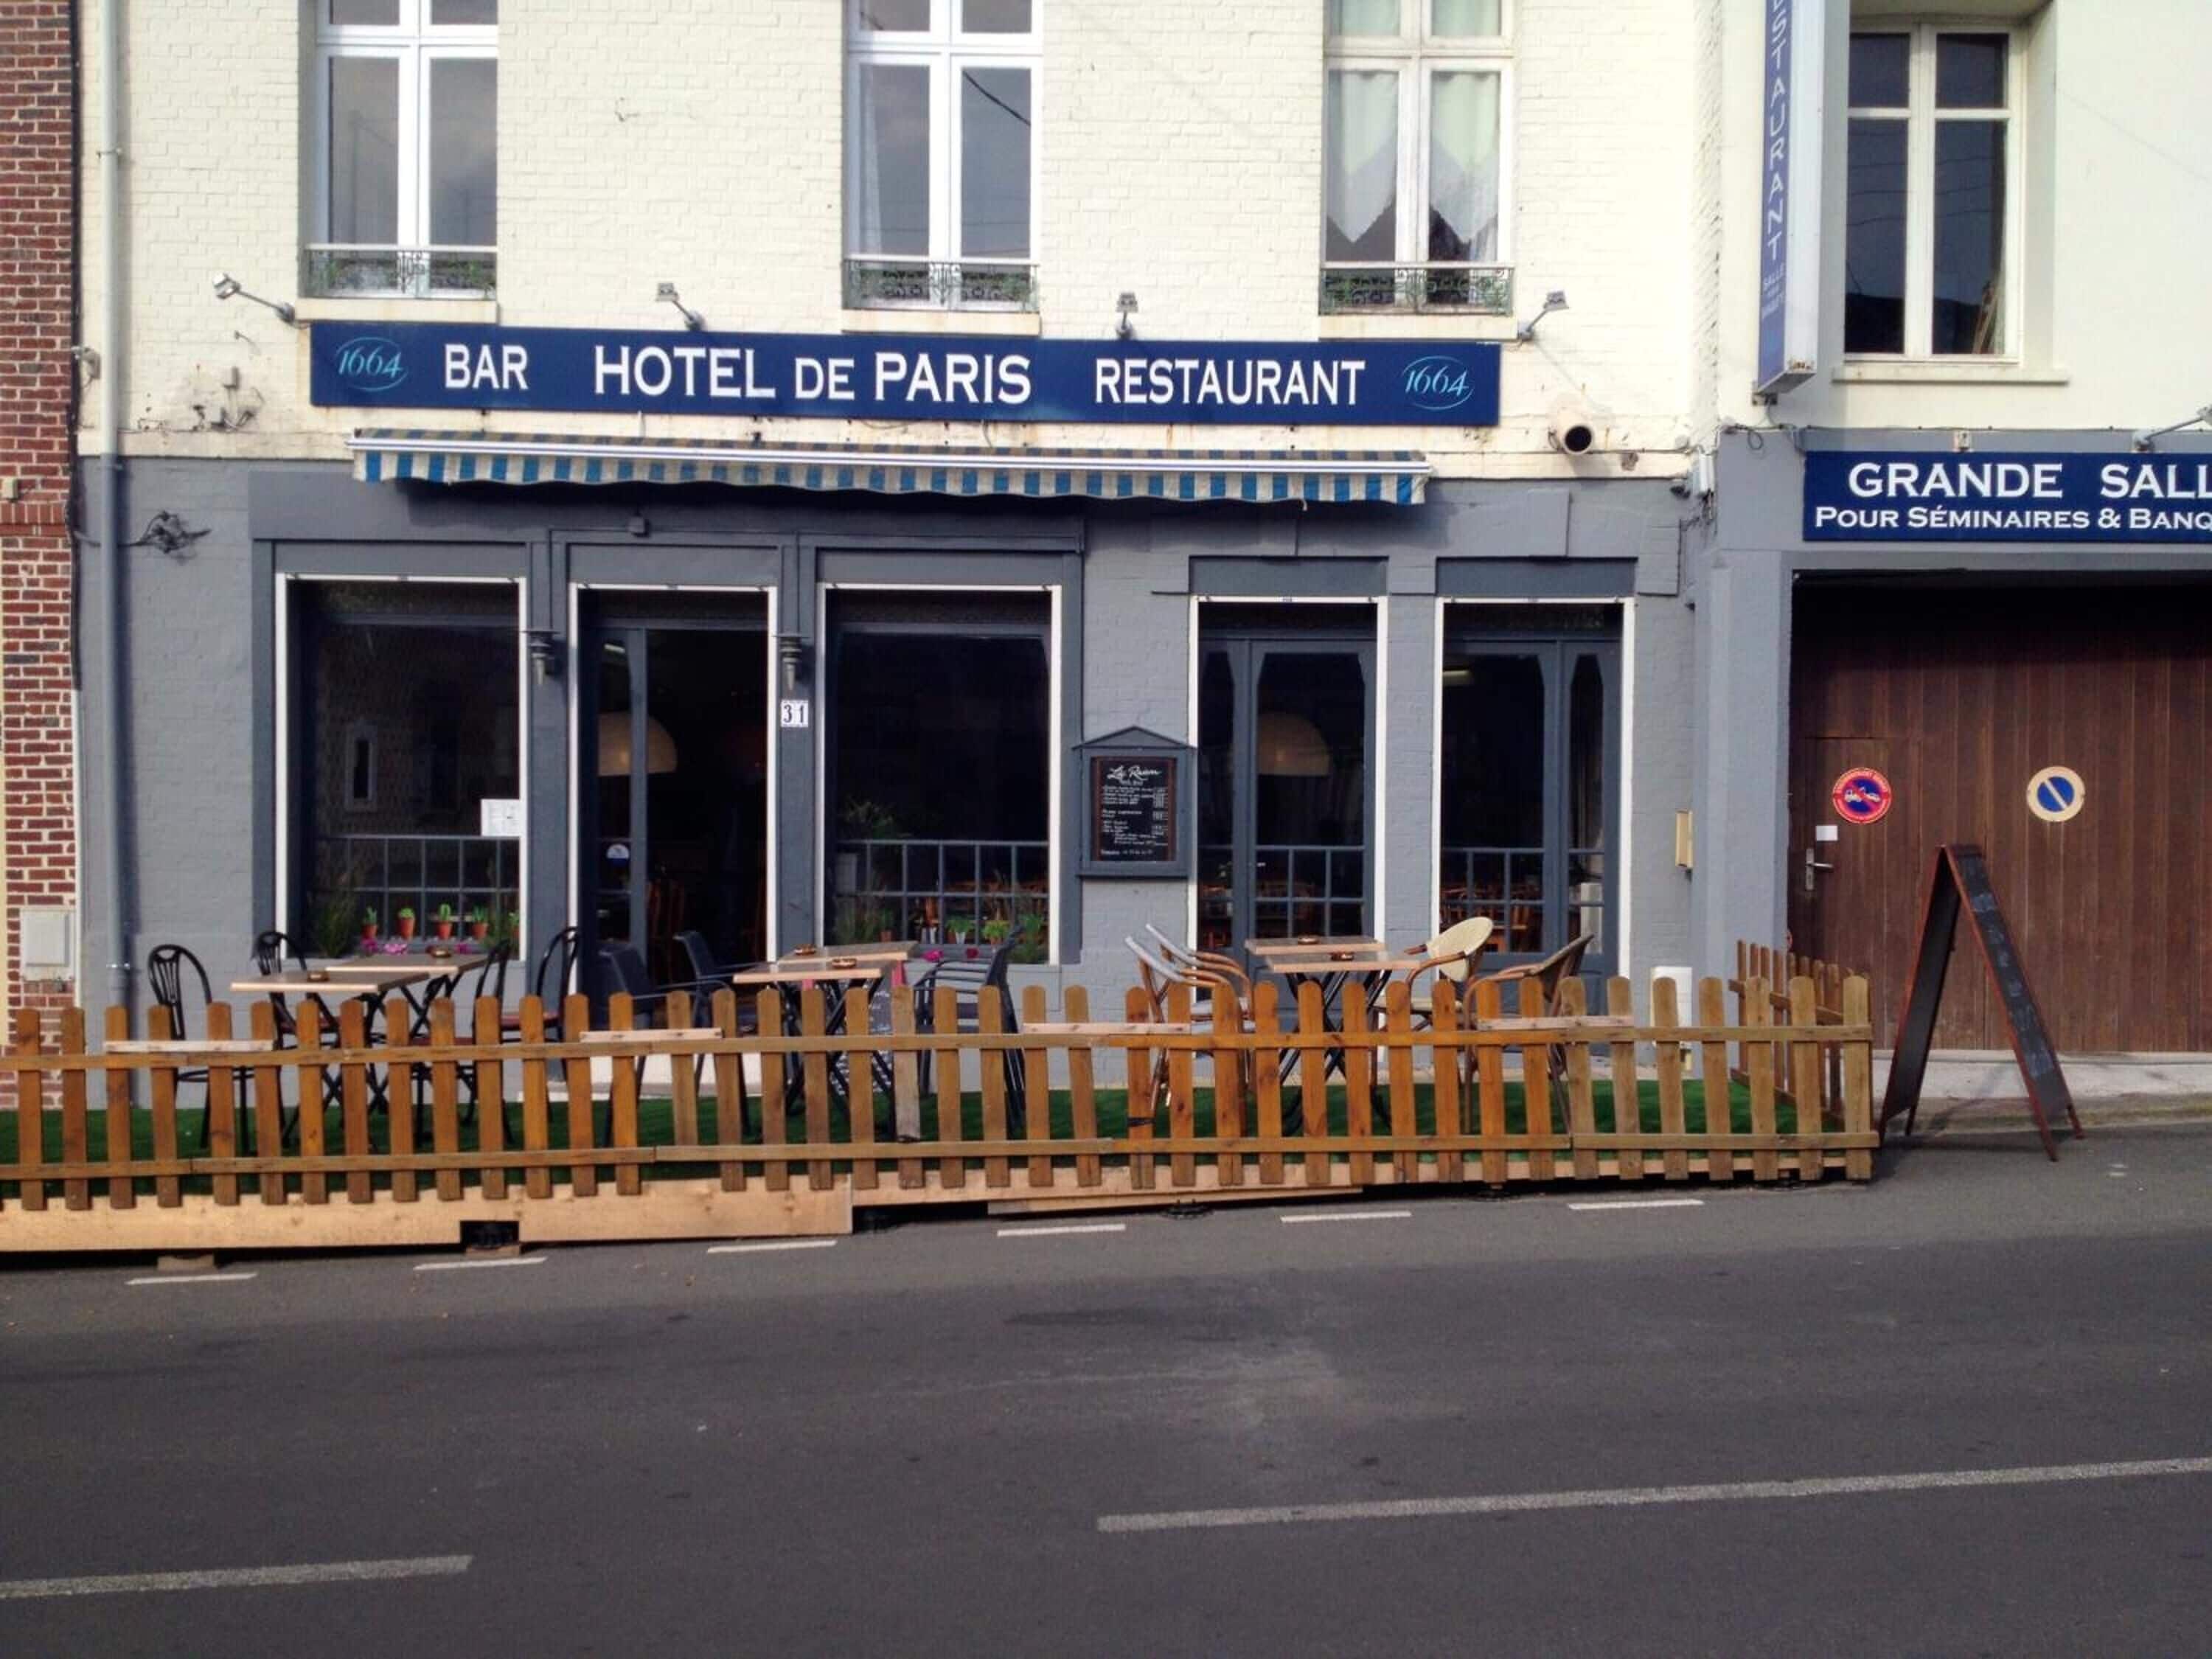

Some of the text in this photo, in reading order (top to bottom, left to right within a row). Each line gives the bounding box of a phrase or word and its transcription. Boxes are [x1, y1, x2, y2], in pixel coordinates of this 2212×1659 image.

[338, 345, 403, 378] 1664
[445, 344, 529, 391] BAR
[595, 345, 1032, 406] HOTEL DE PARIS
[1096, 358, 1366, 406] RESTAURANT
[1405, 365, 1470, 397] 1664
[1848, 462, 2212, 499] GRANDE SALL
[1816, 504, 2212, 532] POUR SÉMINAIRES & BANQ
[784, 704, 804, 723] 31
